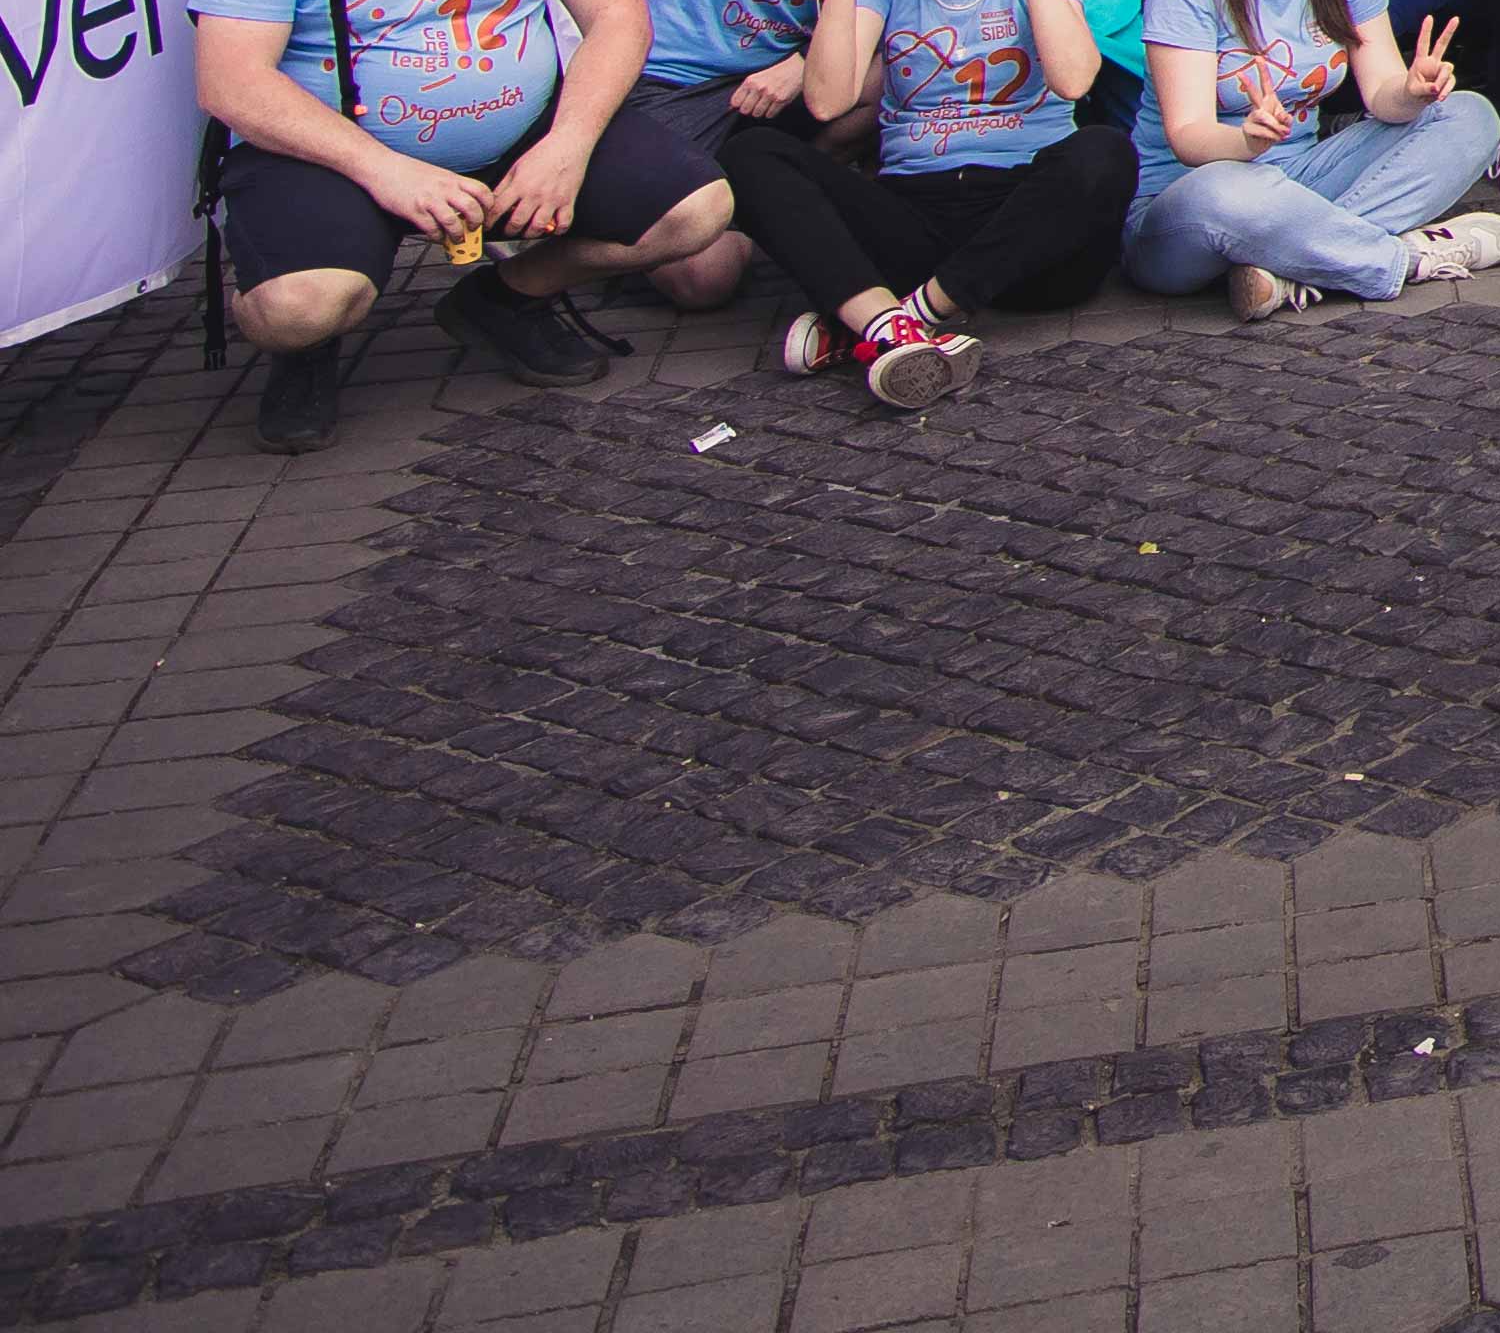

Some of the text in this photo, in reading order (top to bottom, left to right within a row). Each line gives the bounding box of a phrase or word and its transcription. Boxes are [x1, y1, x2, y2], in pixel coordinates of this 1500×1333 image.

[422, 27, 447, 41] Ce
[981, 16, 1018, 42] SIBIU
[424, 40, 449, 53] ne
[379, 85, 525, 143] Organizator
